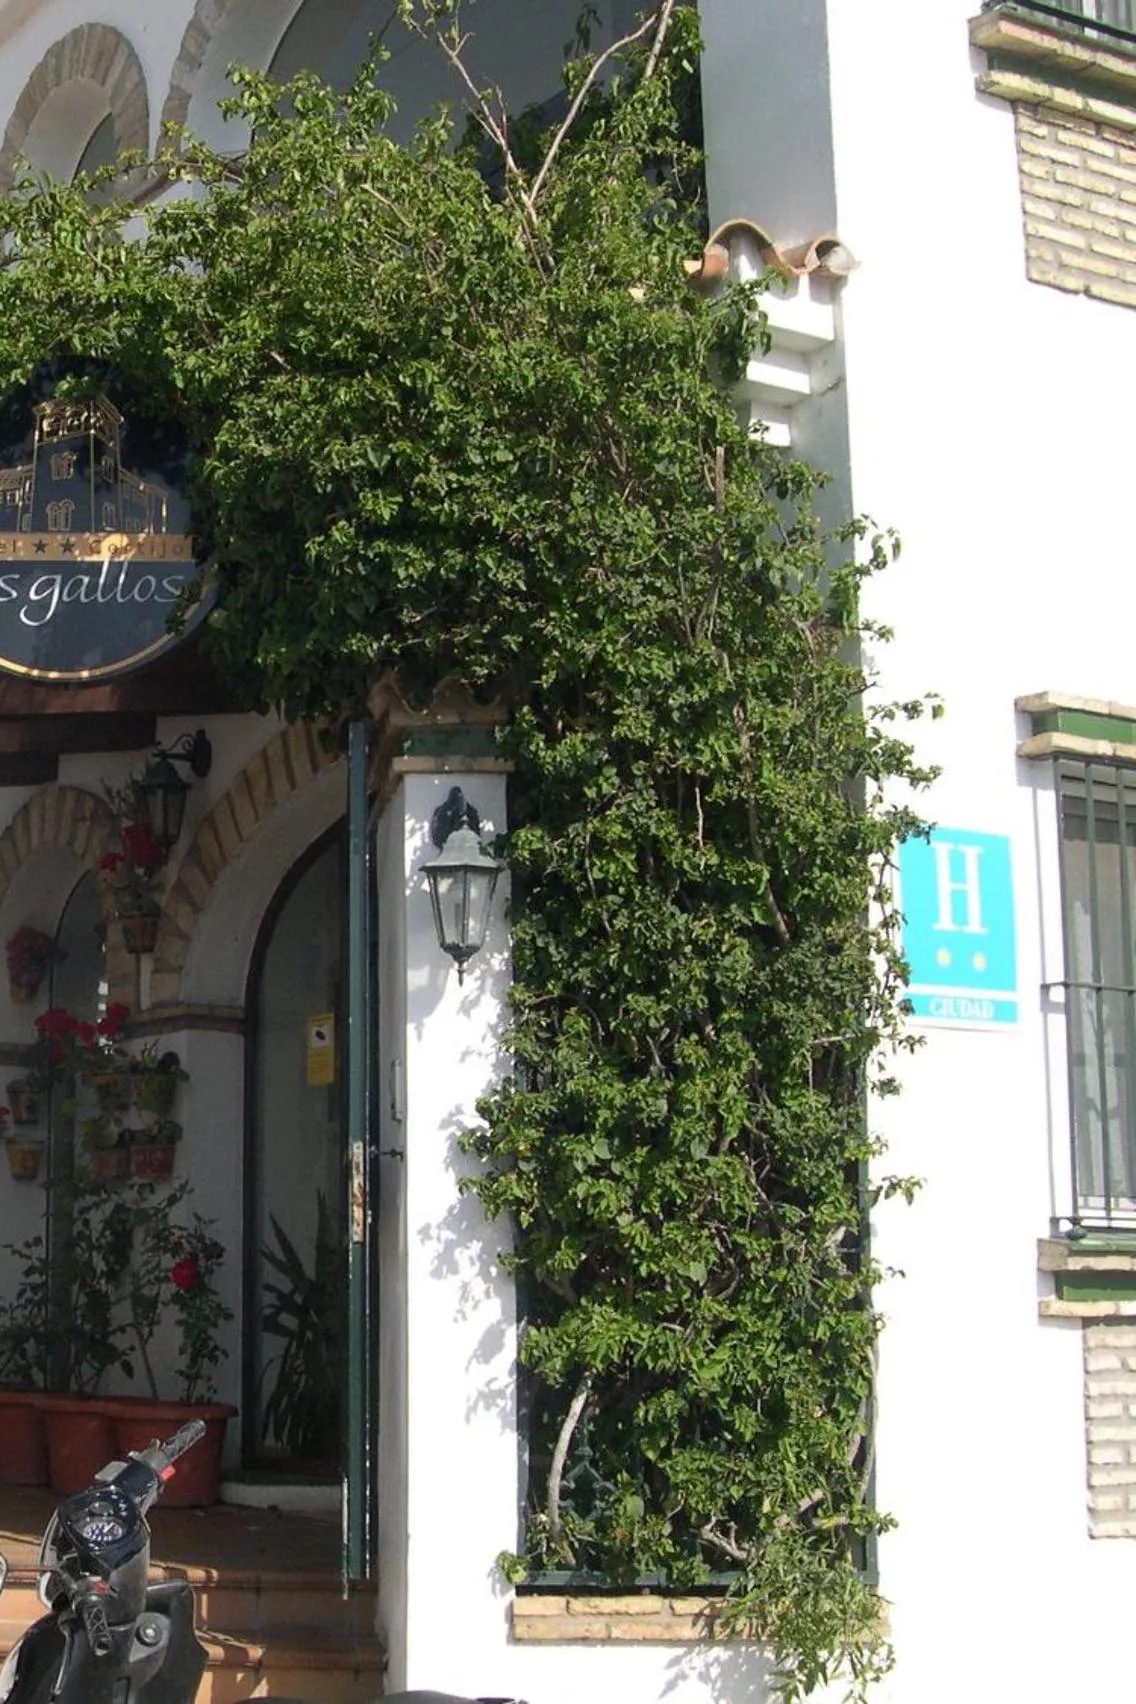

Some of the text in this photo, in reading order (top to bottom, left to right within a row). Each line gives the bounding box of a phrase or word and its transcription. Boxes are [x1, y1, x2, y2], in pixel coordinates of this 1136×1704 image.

[89, 539, 184, 558] Cortijo
[20, 557, 185, 626] gallos
[931, 840, 989, 935] H
[929, 997, 995, 1020] CIUDAD
